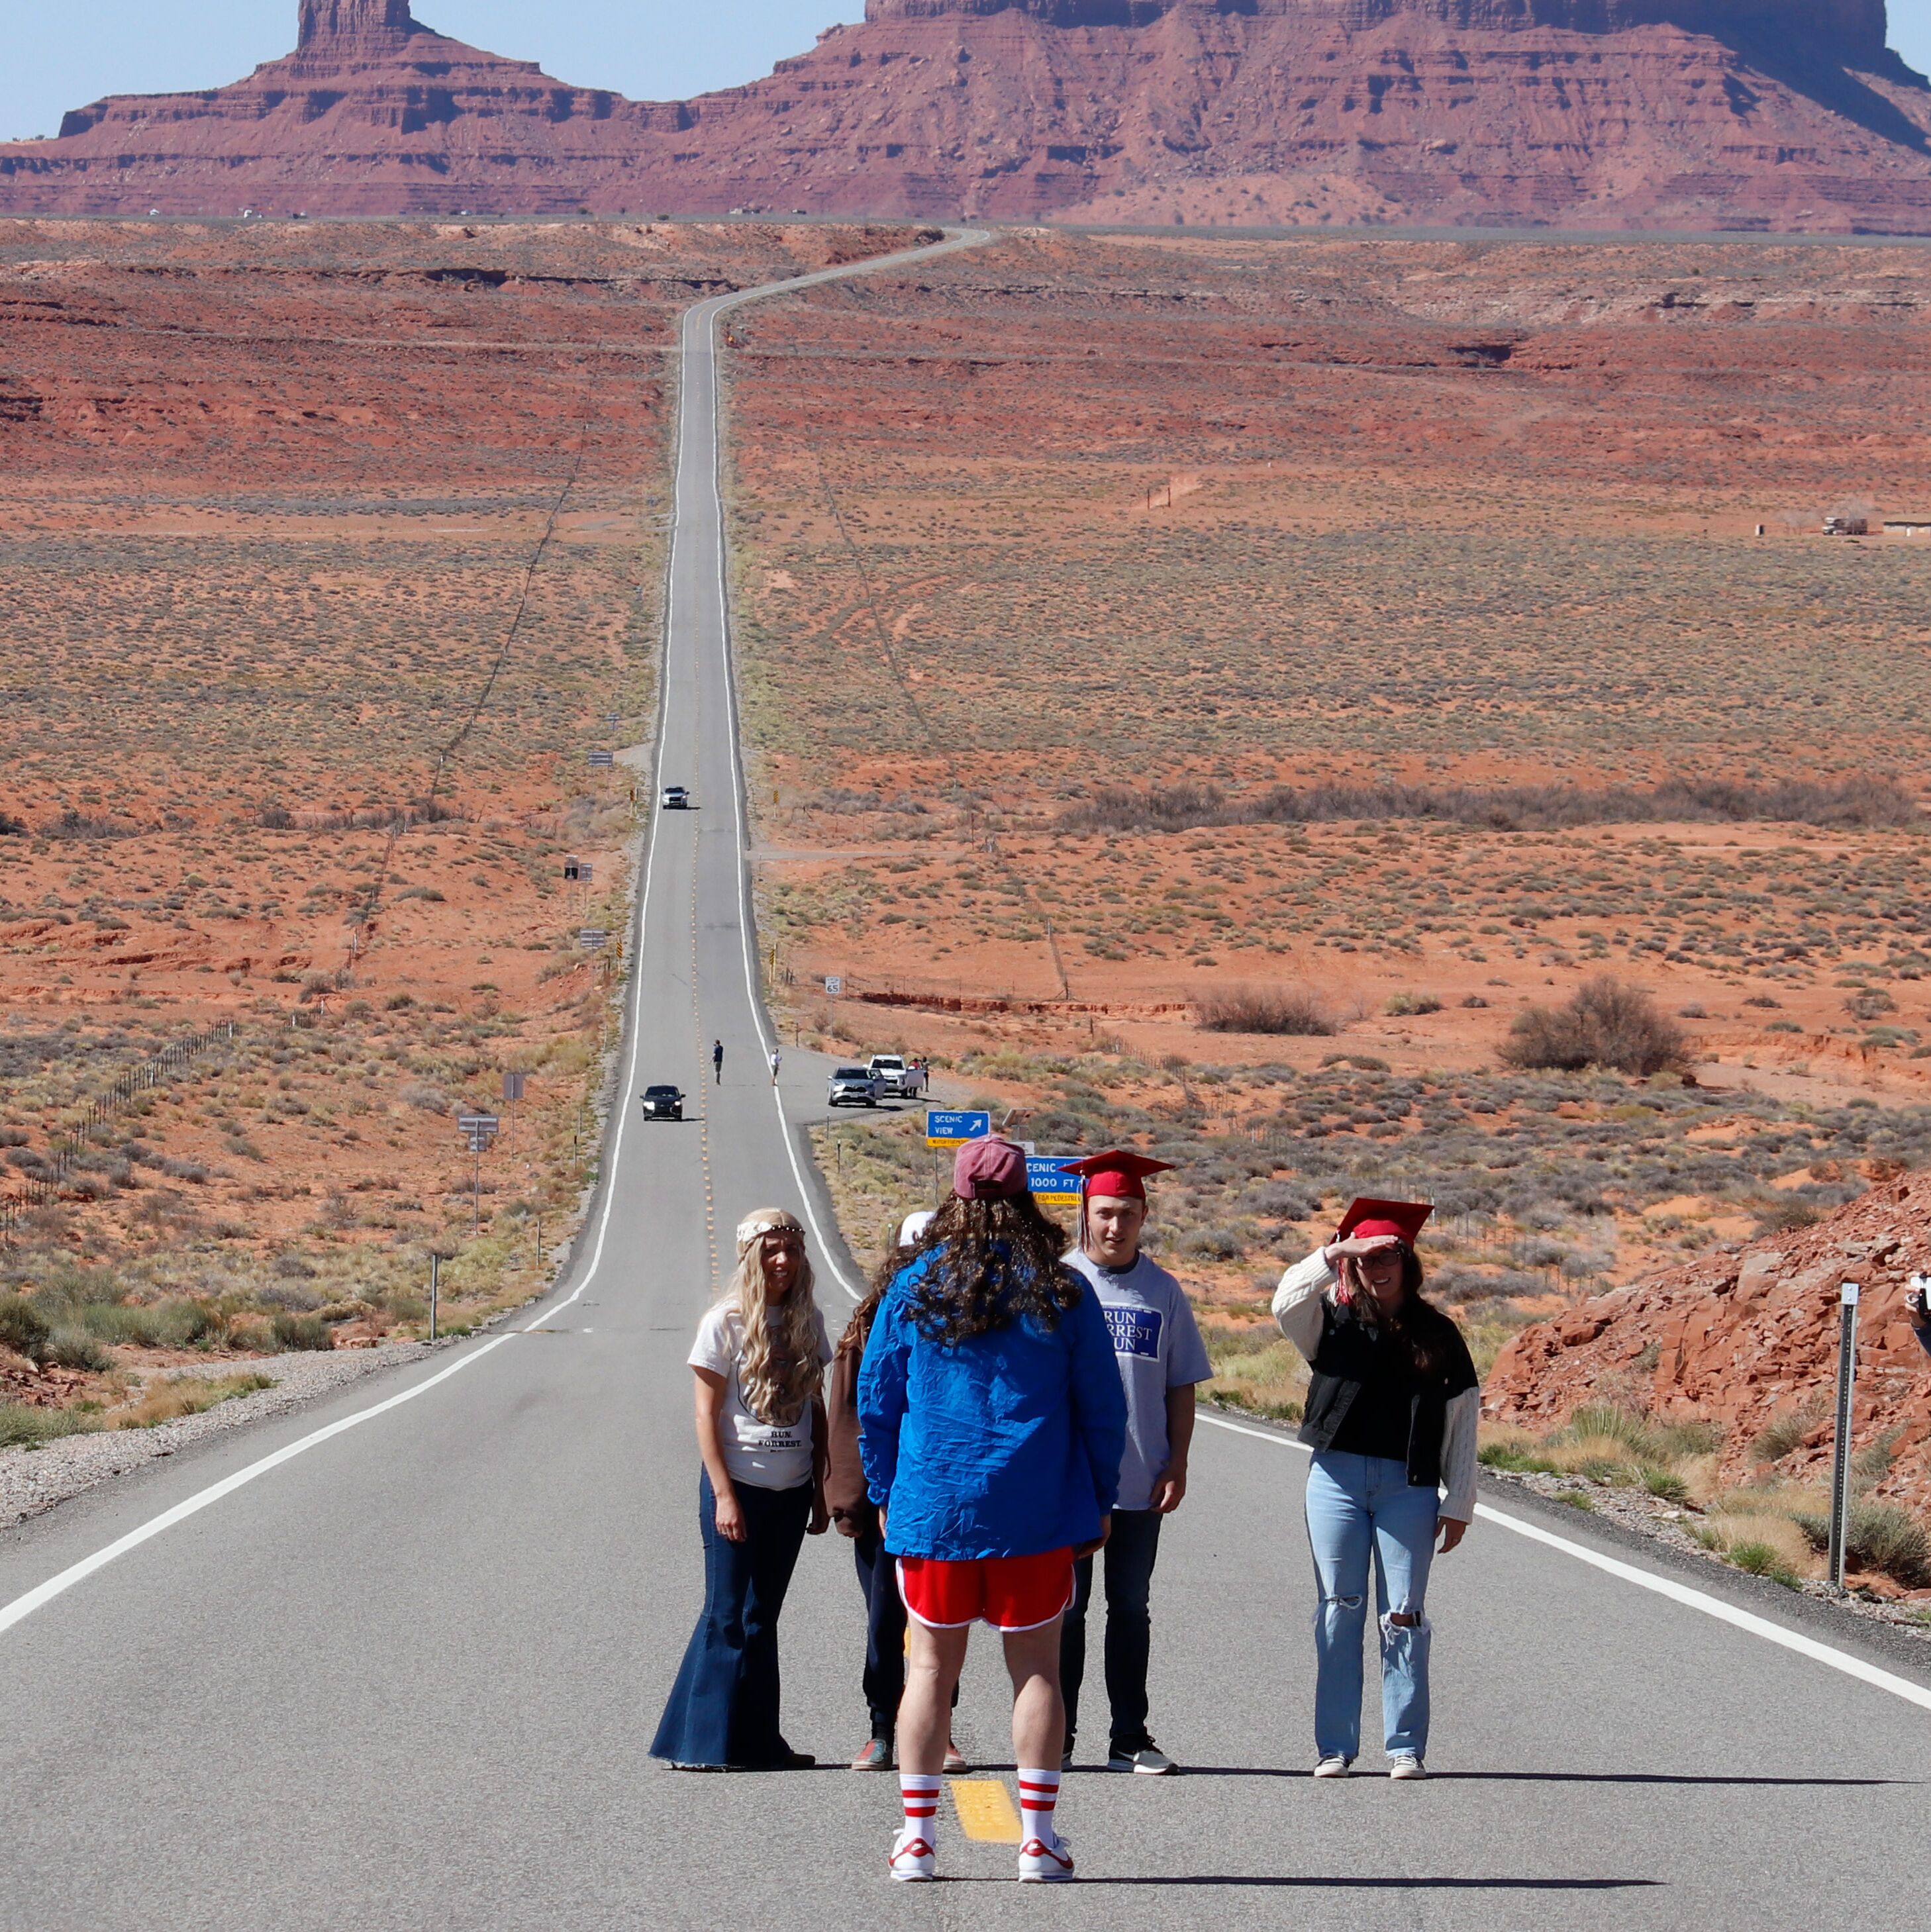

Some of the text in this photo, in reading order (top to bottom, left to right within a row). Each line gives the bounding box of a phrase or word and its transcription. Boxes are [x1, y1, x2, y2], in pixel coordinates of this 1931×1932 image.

[1026, 1163, 1056, 1173] CENIC
[1031, 1178, 1074, 1187] 1000 FT
[1104, 1310, 1136, 1324] RUN
[1107, 1324, 1152, 1340] RREST
[1114, 1337, 1135, 1350] UN
